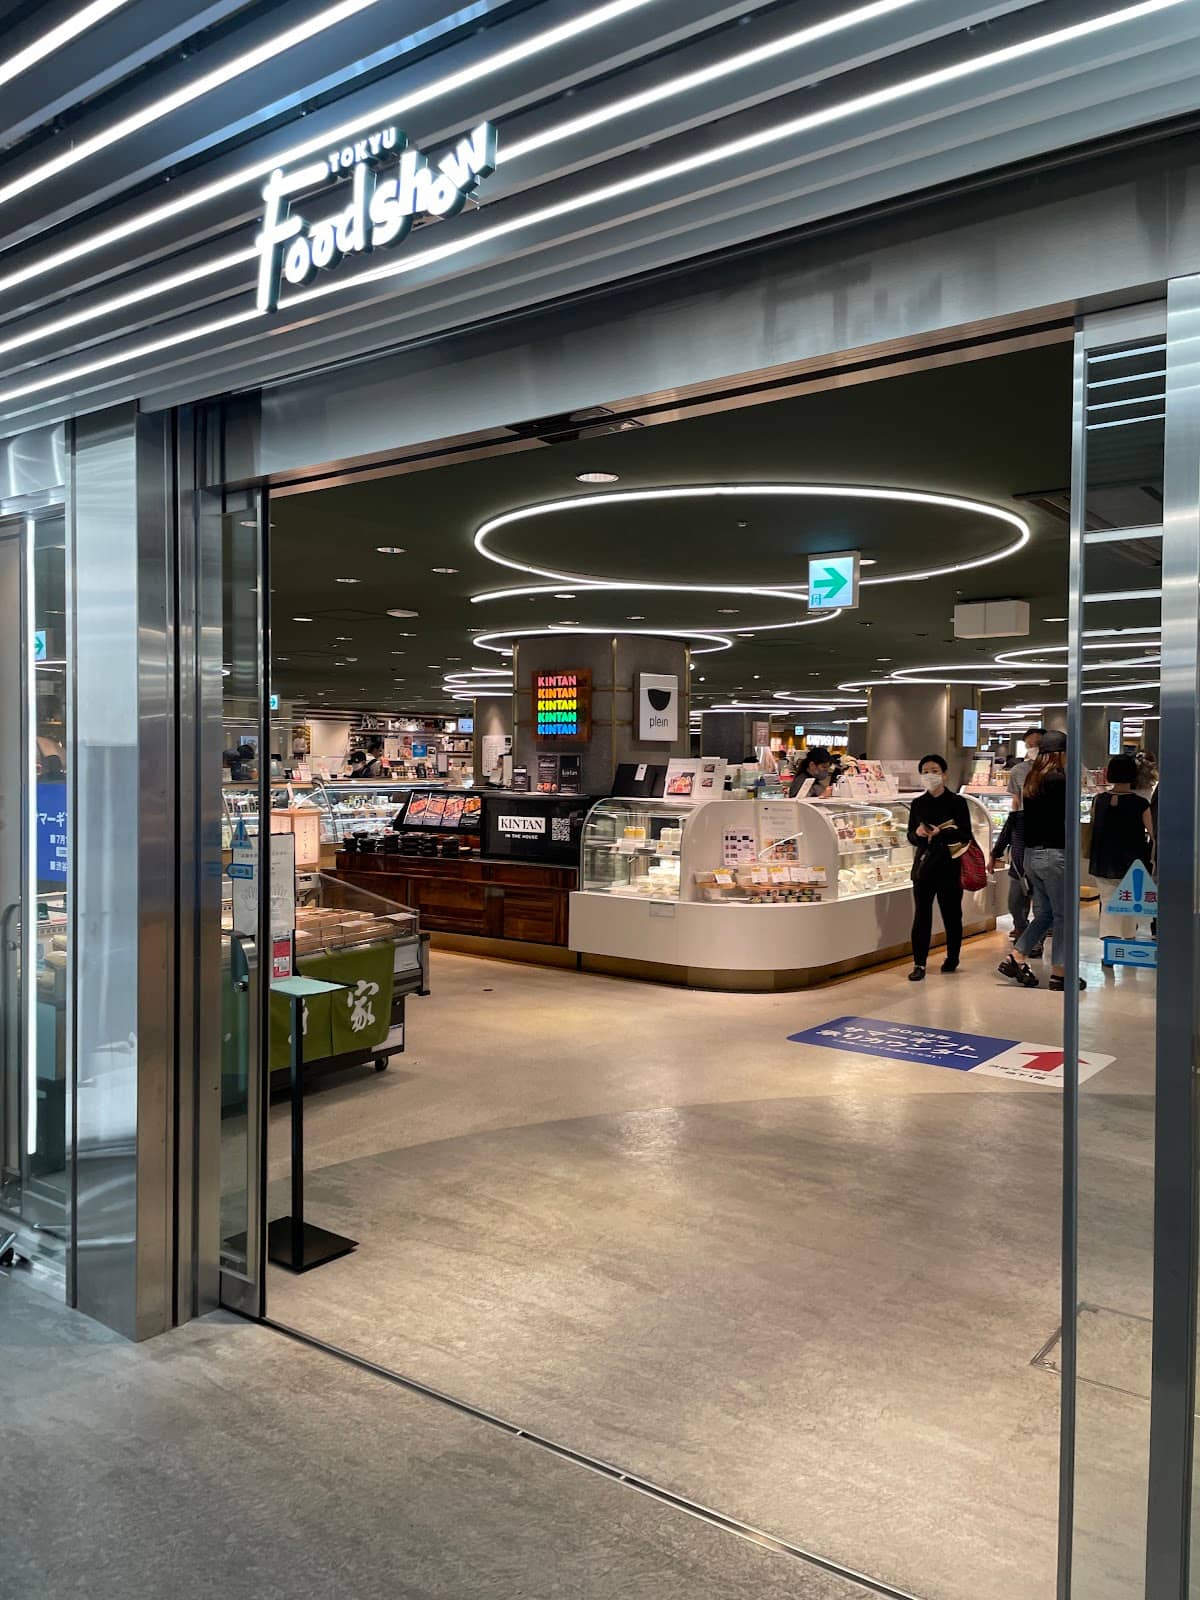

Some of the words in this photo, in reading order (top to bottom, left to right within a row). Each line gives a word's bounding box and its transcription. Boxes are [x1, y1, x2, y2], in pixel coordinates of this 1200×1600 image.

[328, 127, 398, 173] TOKYU
[537, 675, 577, 687] KINTAN
[537, 687, 577, 699] KINTAN
[537, 699, 577, 711] KINTAN
[537, 711, 577, 723] KINTAN
[649, 715, 669, 729] plein
[537, 723, 577, 735] KINTAN
[38, 811, 66, 828] マーギ
[501, 817, 543, 830] KINTAN
[843, 1025, 977, 1052] サマーギフト
[887, 1026, 952, 1041] 2023年
[815, 1029, 980, 1060] 承りカウンター
